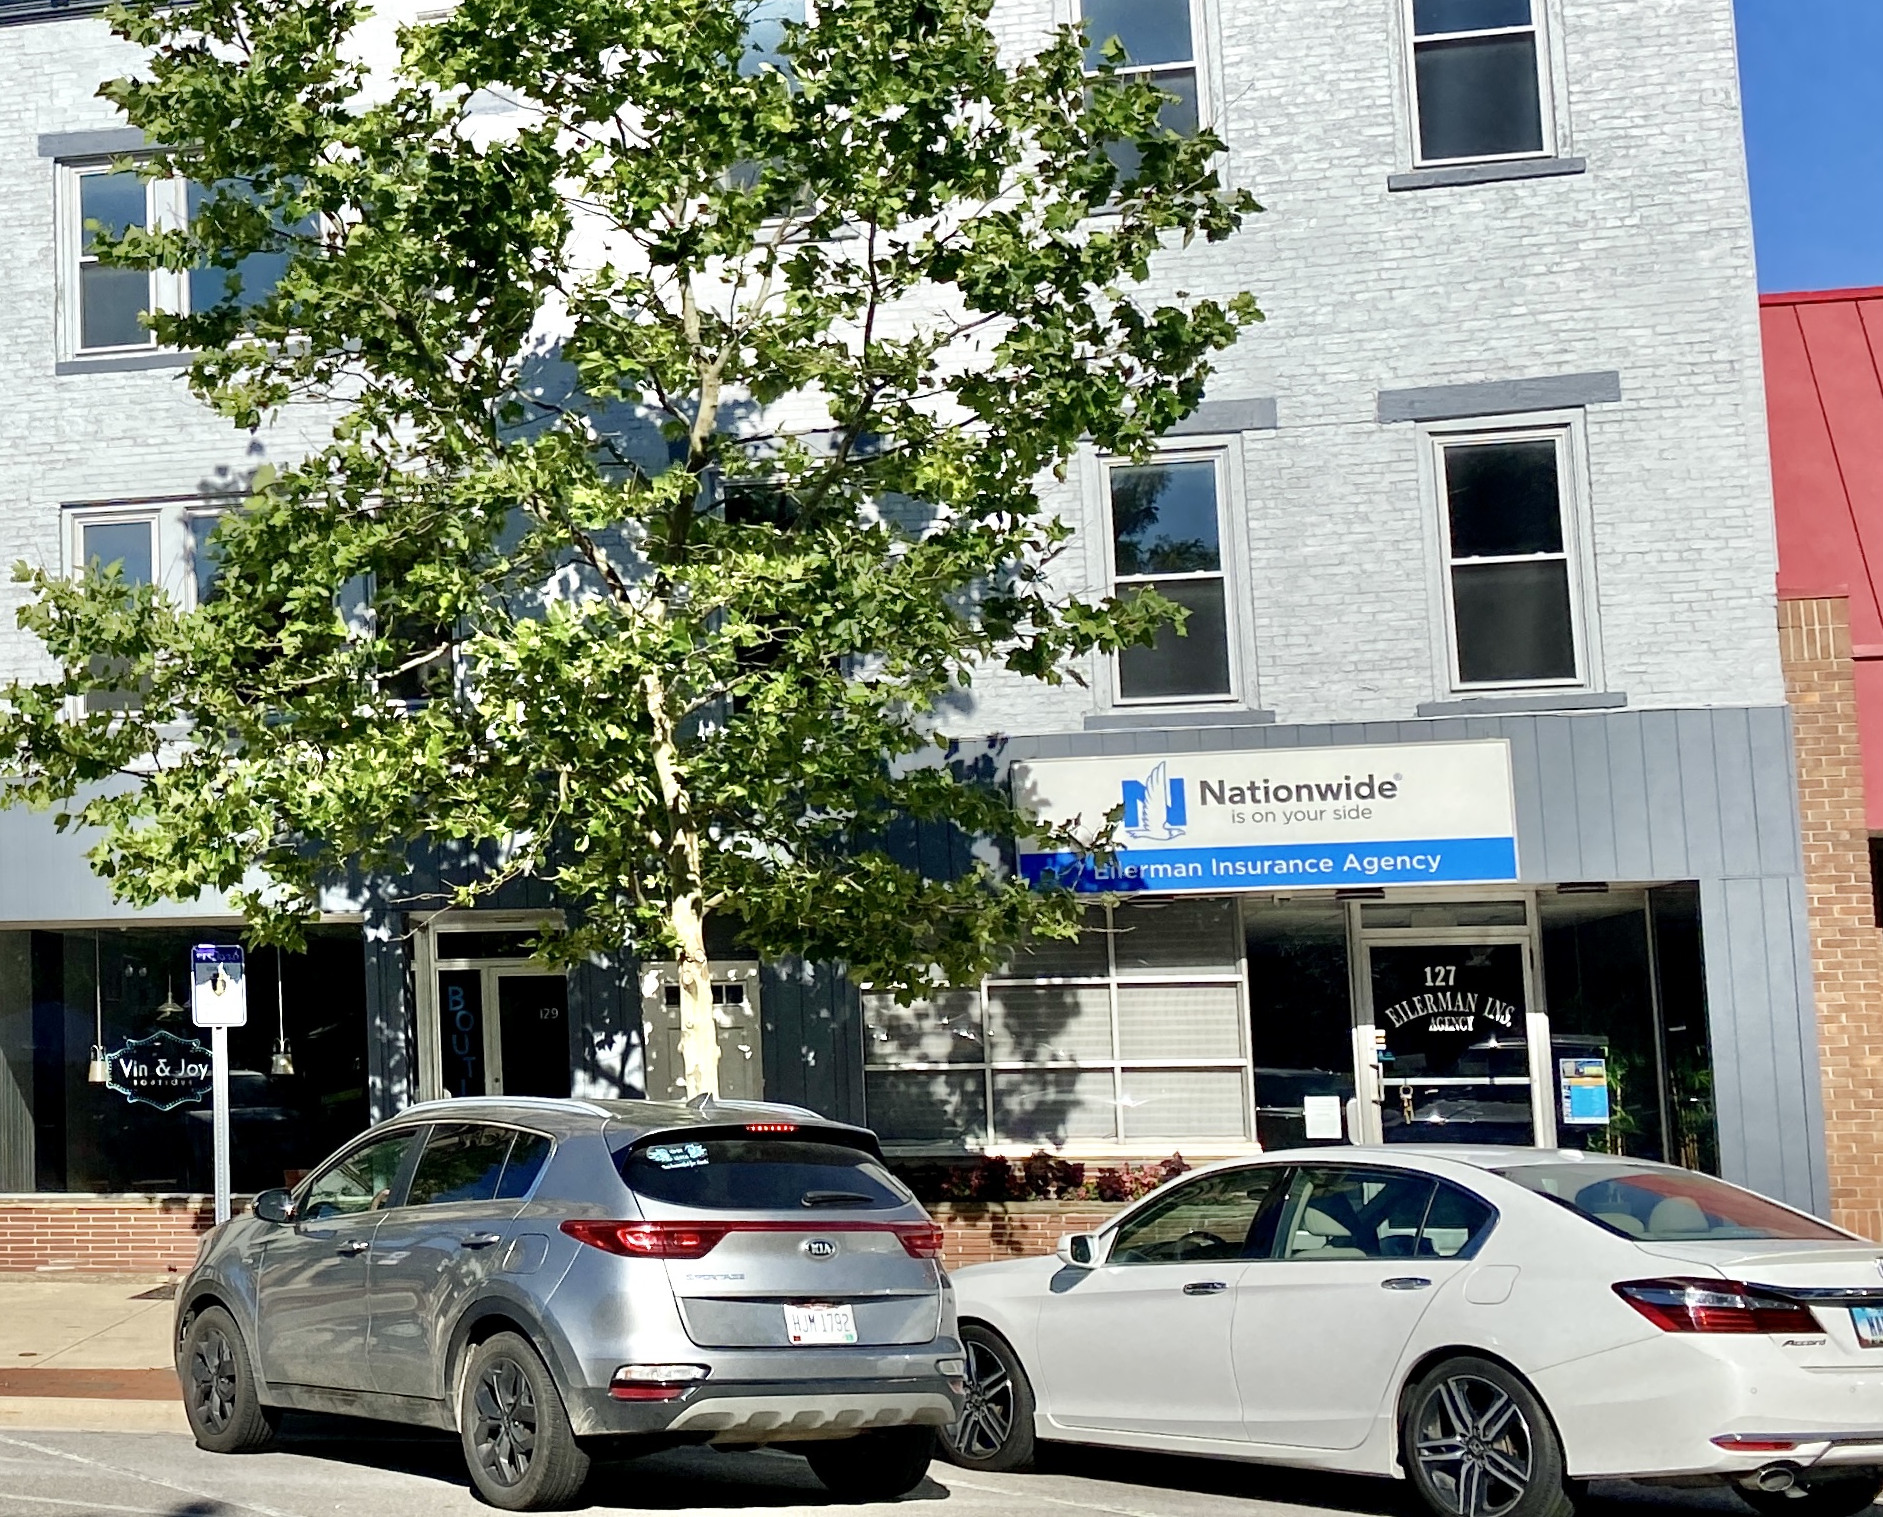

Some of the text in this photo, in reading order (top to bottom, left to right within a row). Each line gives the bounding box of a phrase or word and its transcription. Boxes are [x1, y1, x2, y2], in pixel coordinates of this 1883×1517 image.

[1199, 773, 1399, 806] Nationwide
[1231, 804, 1373, 825] is on your side
[1212, 856, 1334, 876] Insurance
[1343, 853, 1442, 873] Agency
[1424, 965, 1457, 986] 127
[539, 1007, 559, 1020] 129
[1385, 991, 1517, 1028] EILERMAN INS.
[1429, 1015, 1475, 1032] AGENCY
[119, 1057, 209, 1081] Vin & Joy
[810, 1242, 833, 1255] KIA
[820, 1313, 851, 1333] 1792
[1781, 1338, 1827, 1348] Accord
